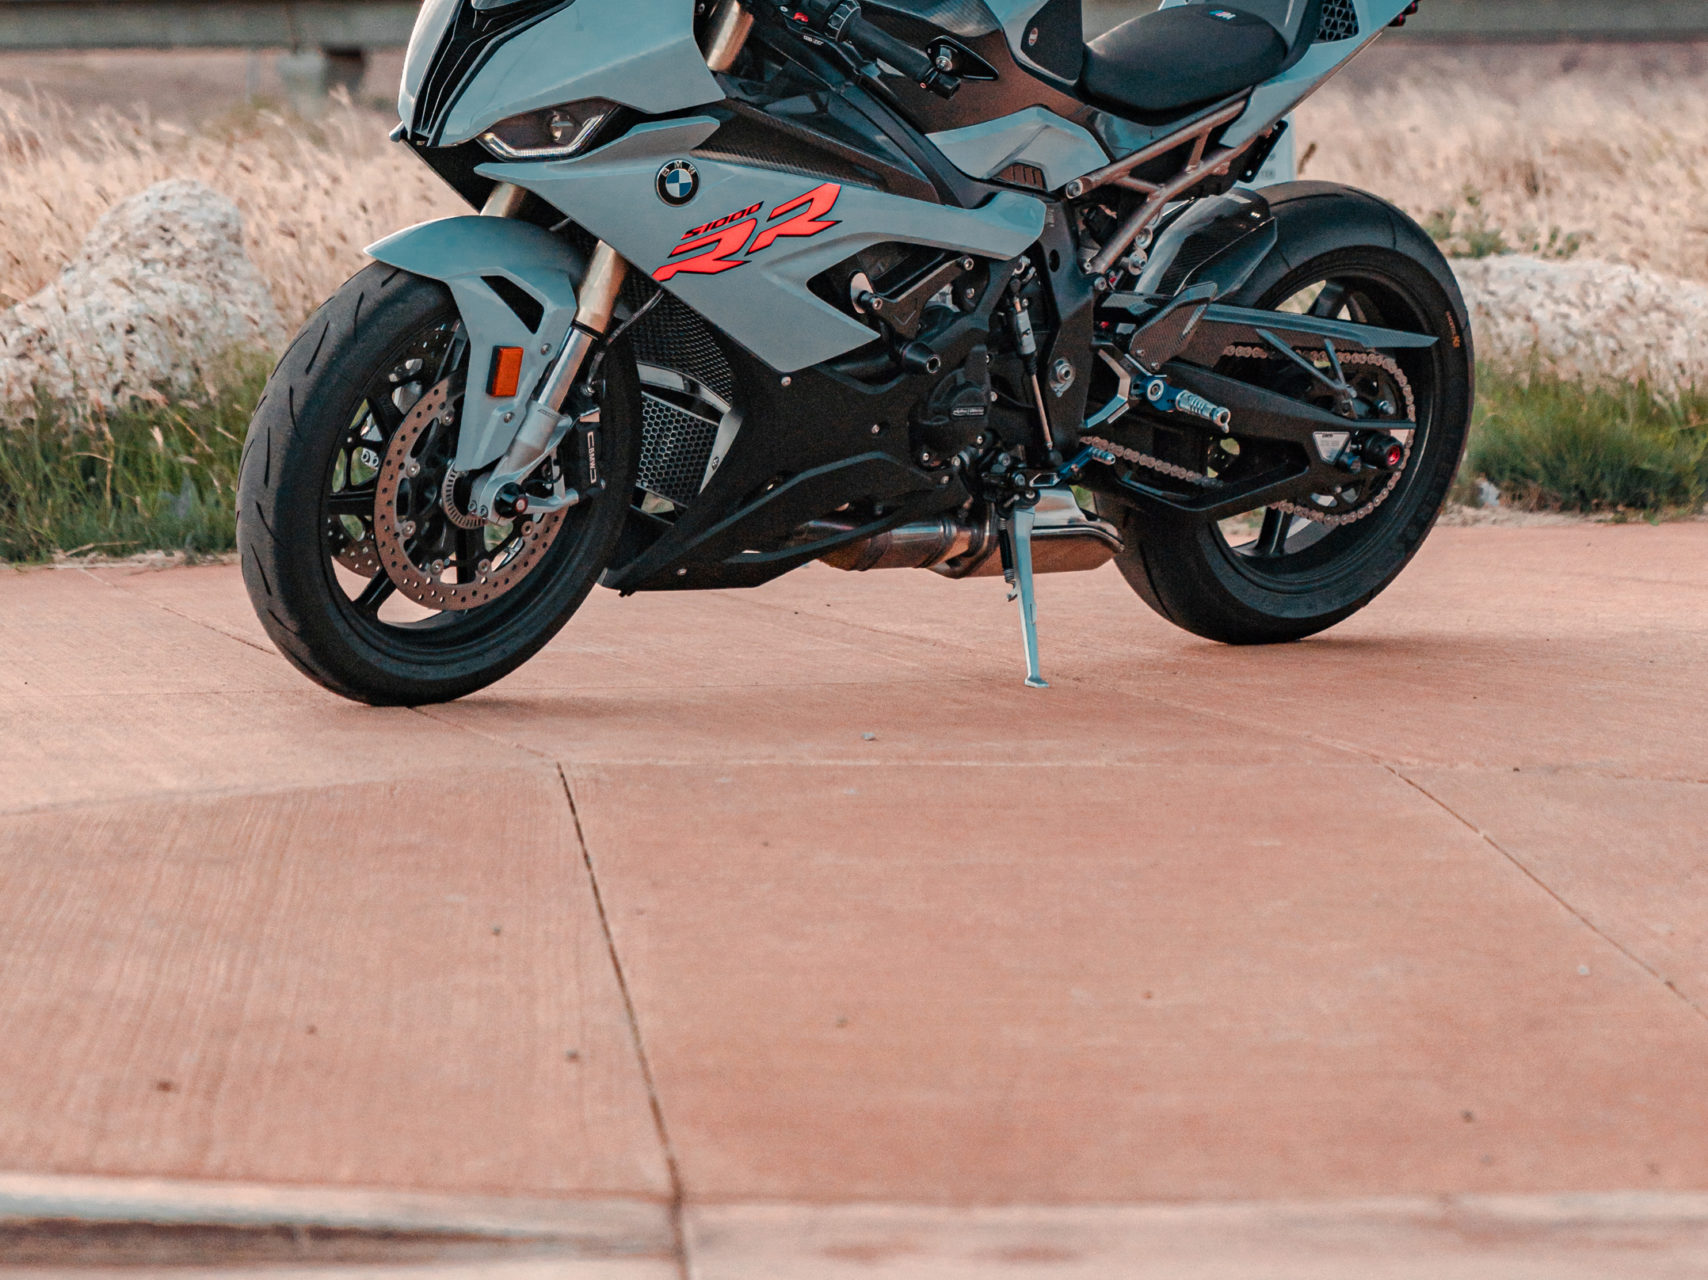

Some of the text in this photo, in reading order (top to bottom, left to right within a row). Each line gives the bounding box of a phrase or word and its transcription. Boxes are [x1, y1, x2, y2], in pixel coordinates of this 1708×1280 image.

[661, 160, 697, 177] BMW
[651, 183, 843, 282] RR
[681, 200, 765, 240] S1000
